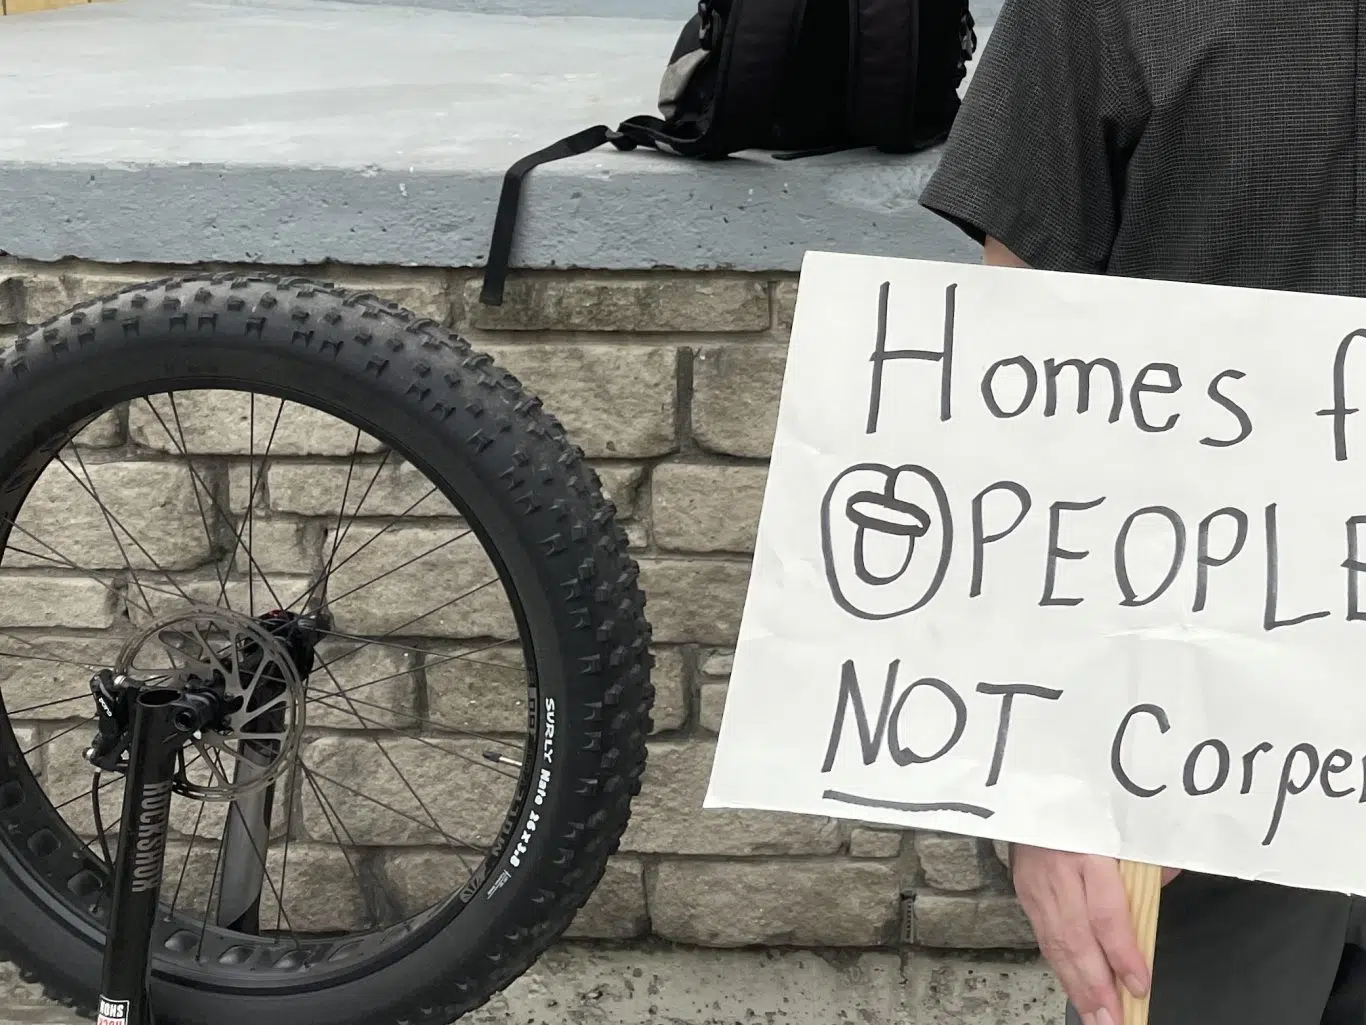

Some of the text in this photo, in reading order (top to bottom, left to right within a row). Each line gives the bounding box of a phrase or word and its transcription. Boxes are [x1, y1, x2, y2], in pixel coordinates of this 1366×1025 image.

[866, 280, 1253, 448] Homes
[544, 697, 556, 764] SURLY
[821, 658, 1064, 787] NOT
